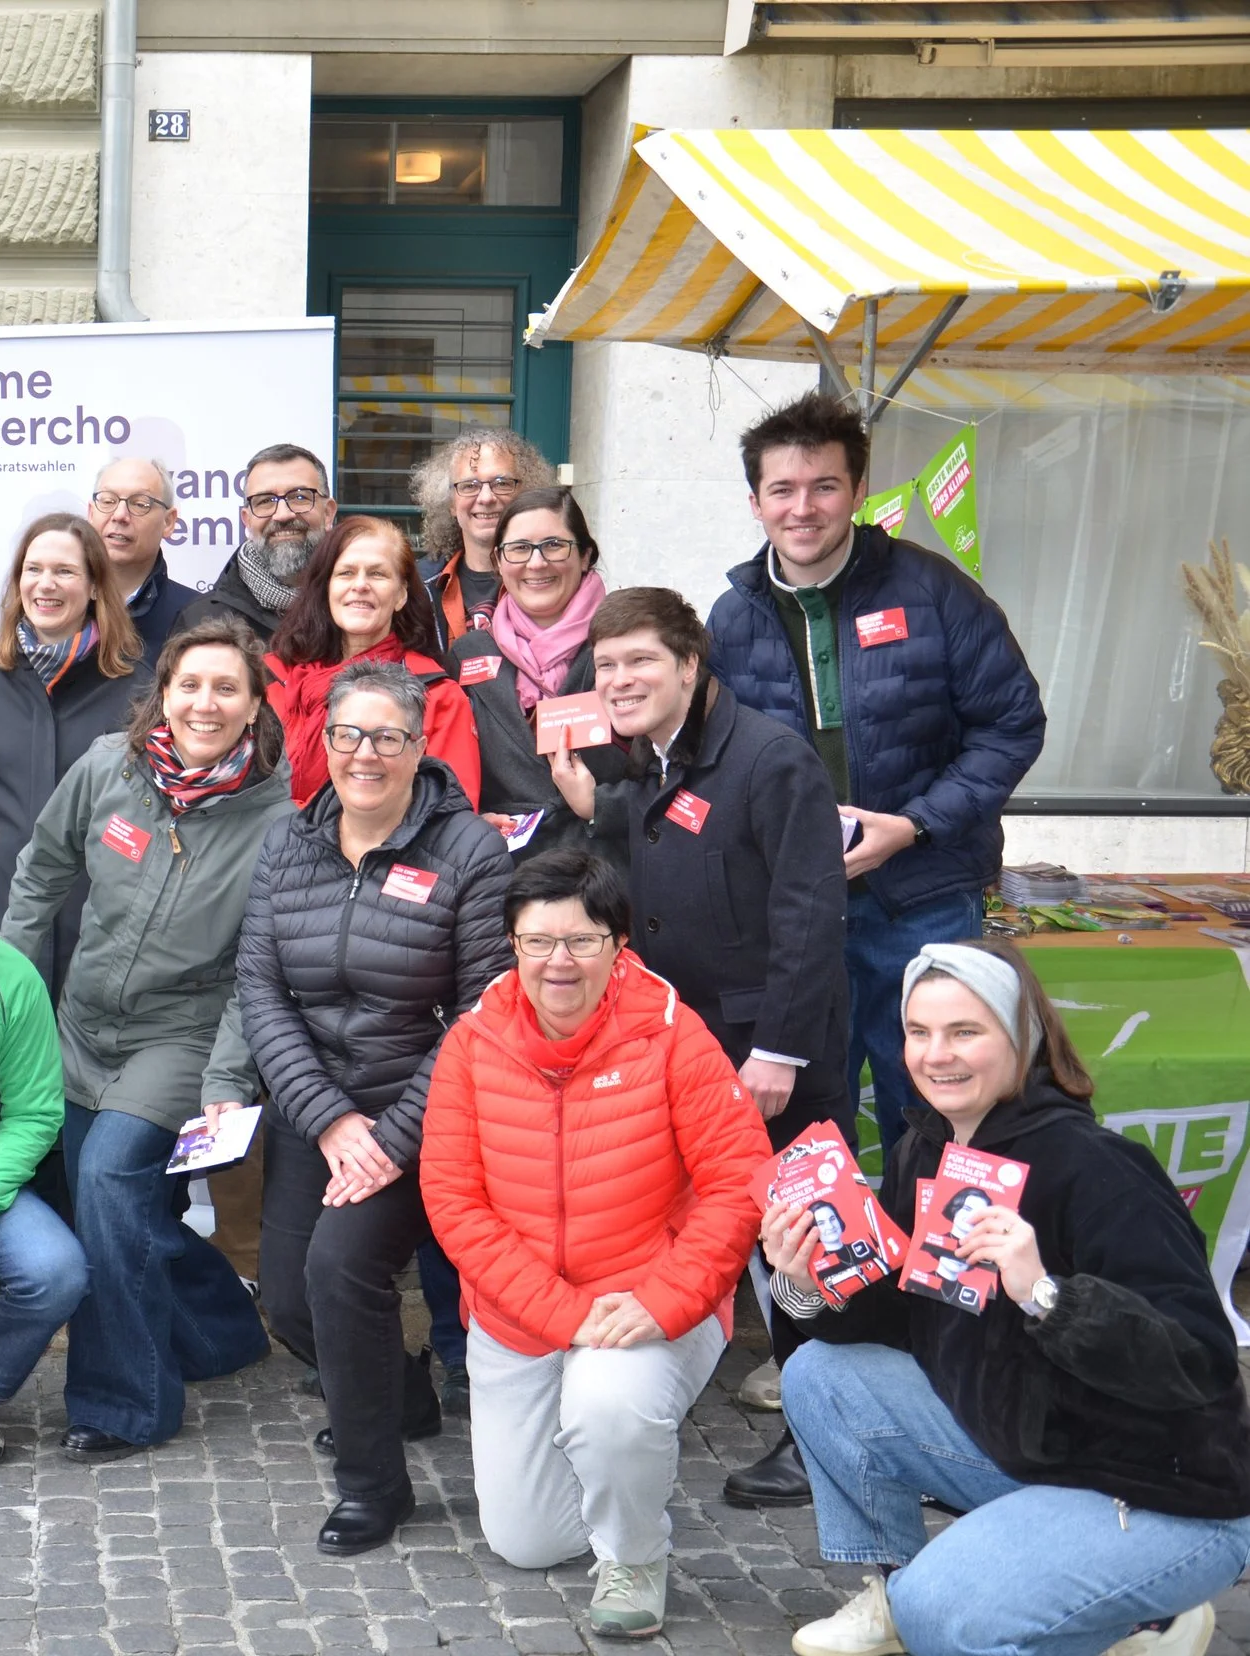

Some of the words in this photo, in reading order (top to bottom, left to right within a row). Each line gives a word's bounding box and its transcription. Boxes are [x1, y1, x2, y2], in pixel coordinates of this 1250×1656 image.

[156, 114, 184, 135] 28
[928, 468, 948, 497] ERSTE
[947, 447, 966, 478] WAHL
[932, 491, 950, 517] FÜRS
[947, 464, 971, 496] KLIMA
[944, 1161, 987, 1179] SOZIALEN
[946, 1152, 965, 1164] FÜR
[965, 1158, 993, 1173] EINEN
[780, 1184, 794, 1197] FÜR
[793, 1176, 815, 1192] EINEN
[942, 1168, 979, 1185] KANTON
